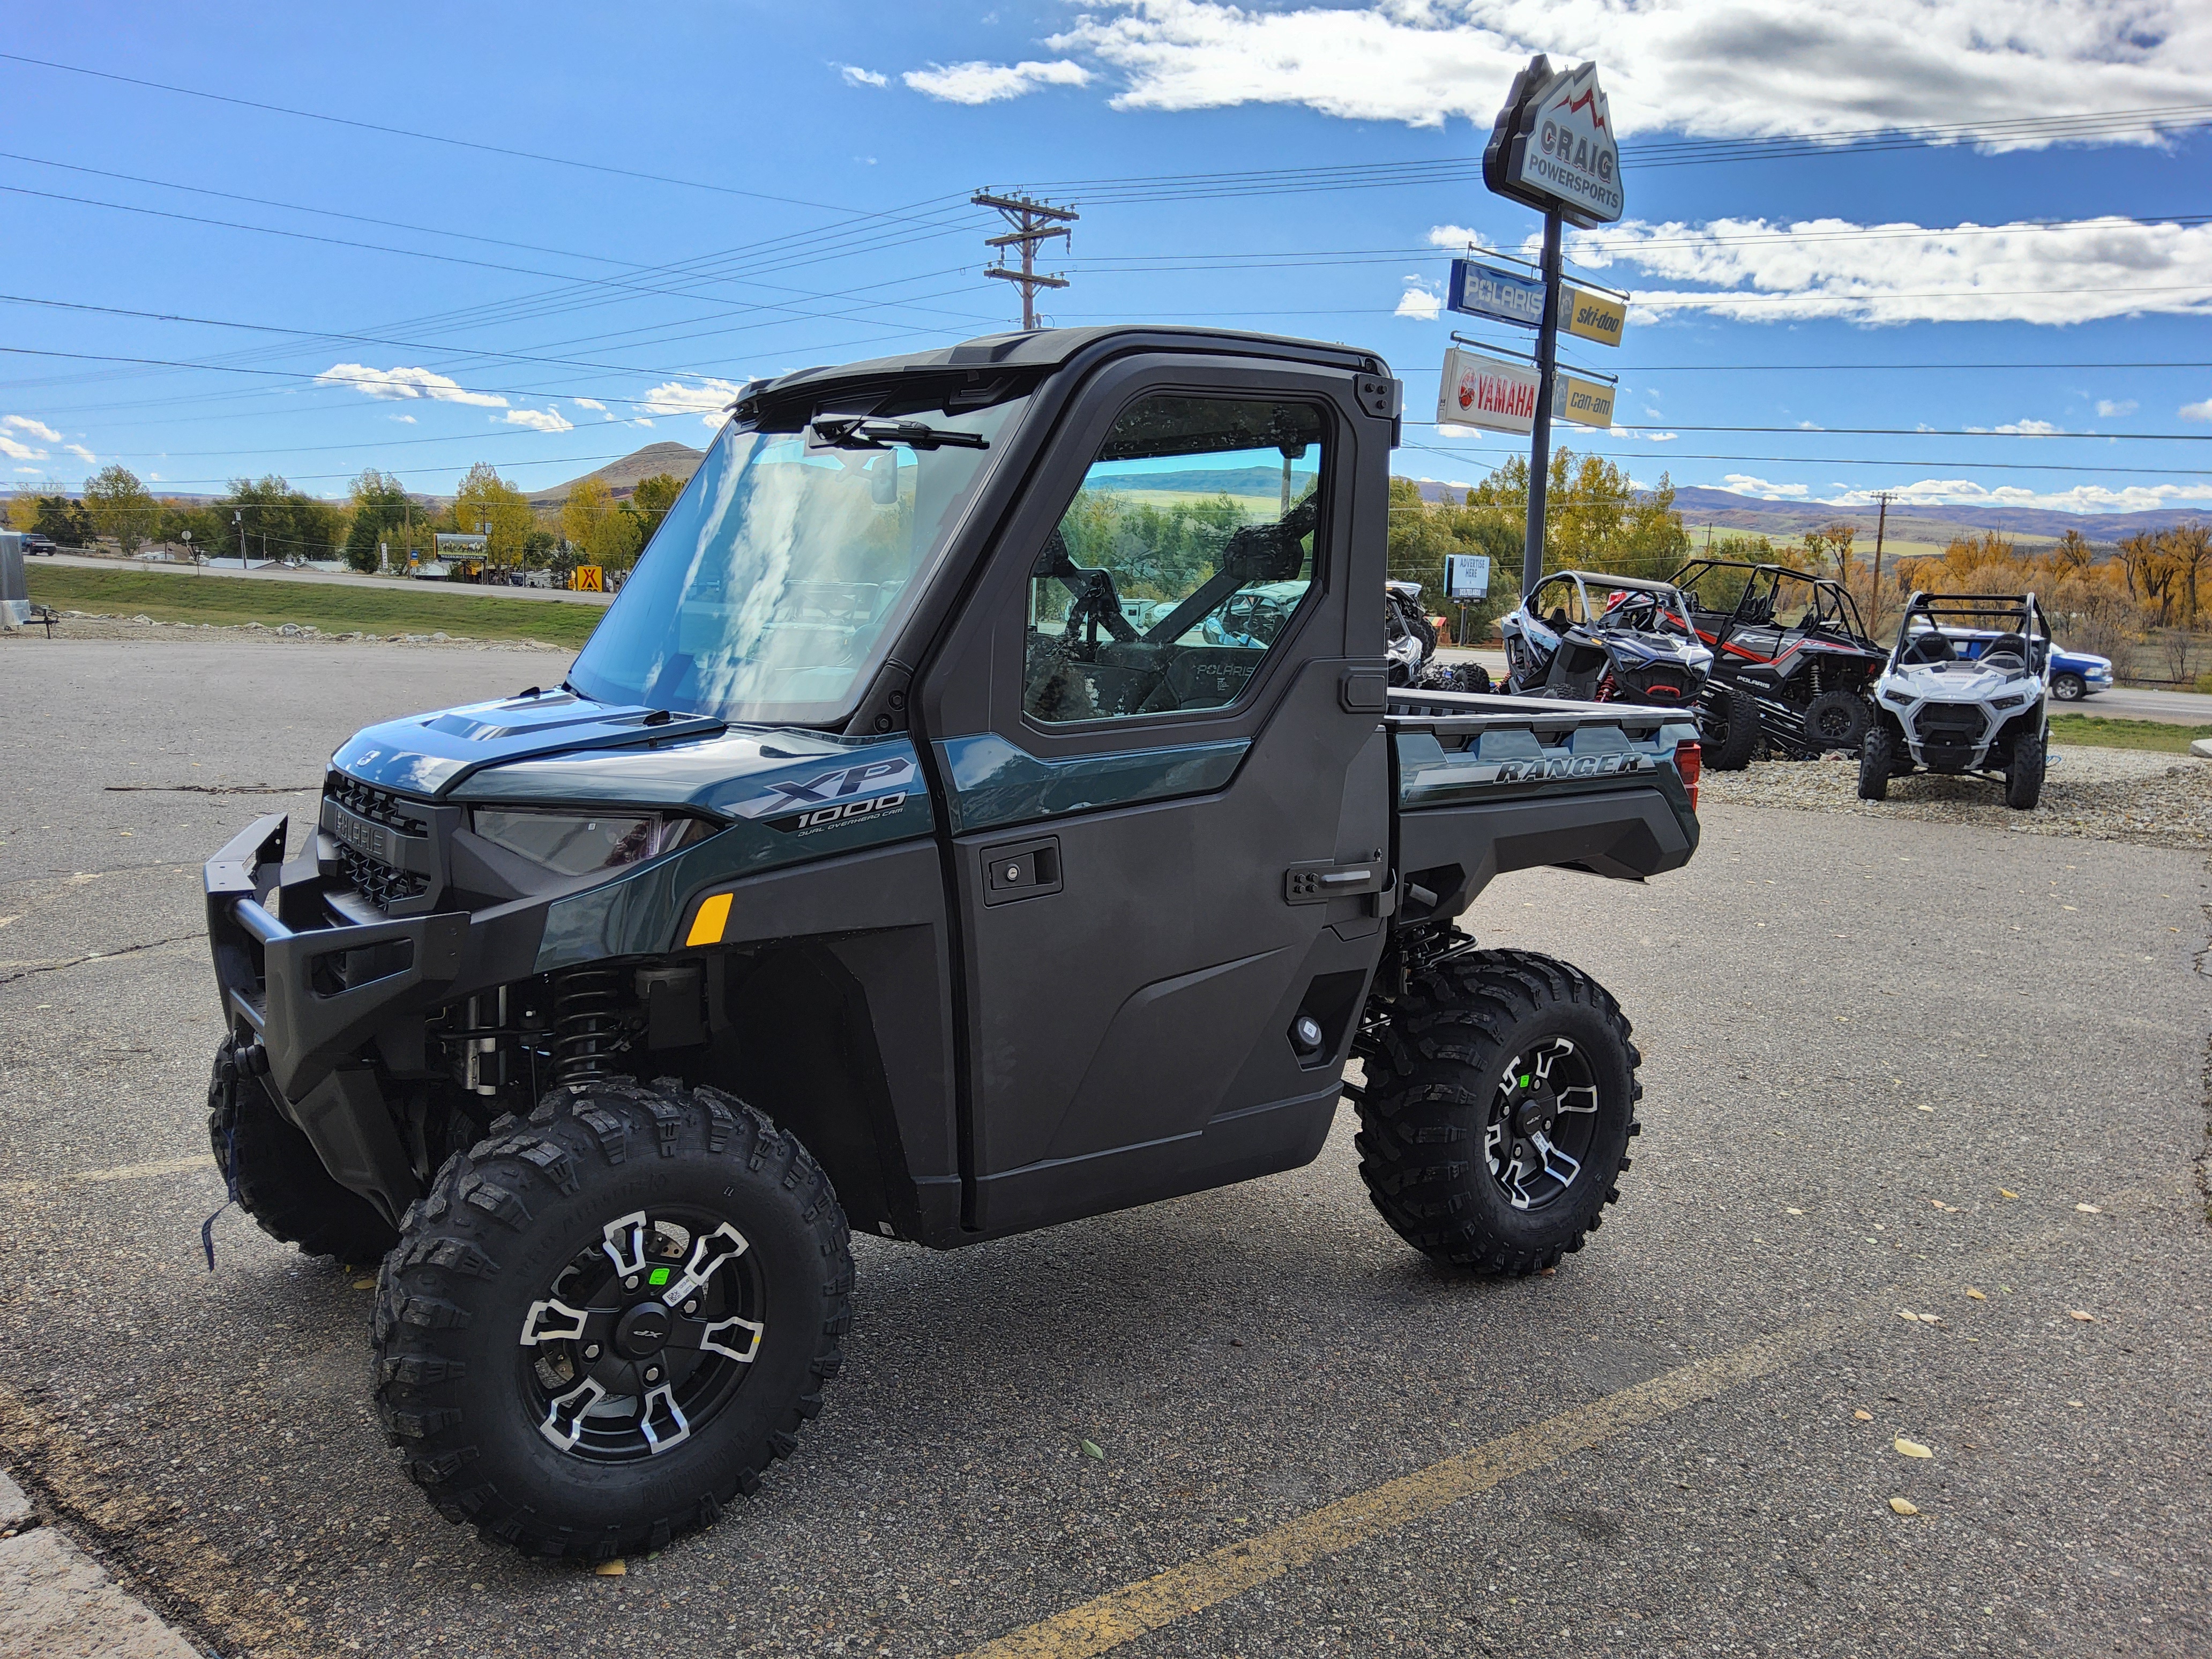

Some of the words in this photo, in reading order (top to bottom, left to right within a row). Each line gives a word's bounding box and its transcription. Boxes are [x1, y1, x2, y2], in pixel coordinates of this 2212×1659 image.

[1540, 118, 1613, 184] CRAIG
[1528, 153, 1619, 209] POWERSPORTS
[1465, 275, 1544, 315] POLARIS
[1576, 305, 1620, 333] ski-doo
[1477, 373, 1535, 419] YAMAHA
[1570, 391, 1611, 416] can-am
[1459, 558, 1485, 569] ADVERTISE
[1465, 568, 1477, 578] HERE
[1197, 664, 1254, 676] POLARIS
[1736, 675, 1770, 689] POLARIS
[1492, 752, 1643, 784] RANGER
[751, 757, 910, 816] XP
[798, 791, 908, 828] 1000
[798, 827, 825, 837] DUAL
[827, 813, 880, 830] OVERHEAD
[882, 808, 903, 817] CAM
[336, 810, 384, 855] POLARIS
[633, 1330, 663, 1338] XP
